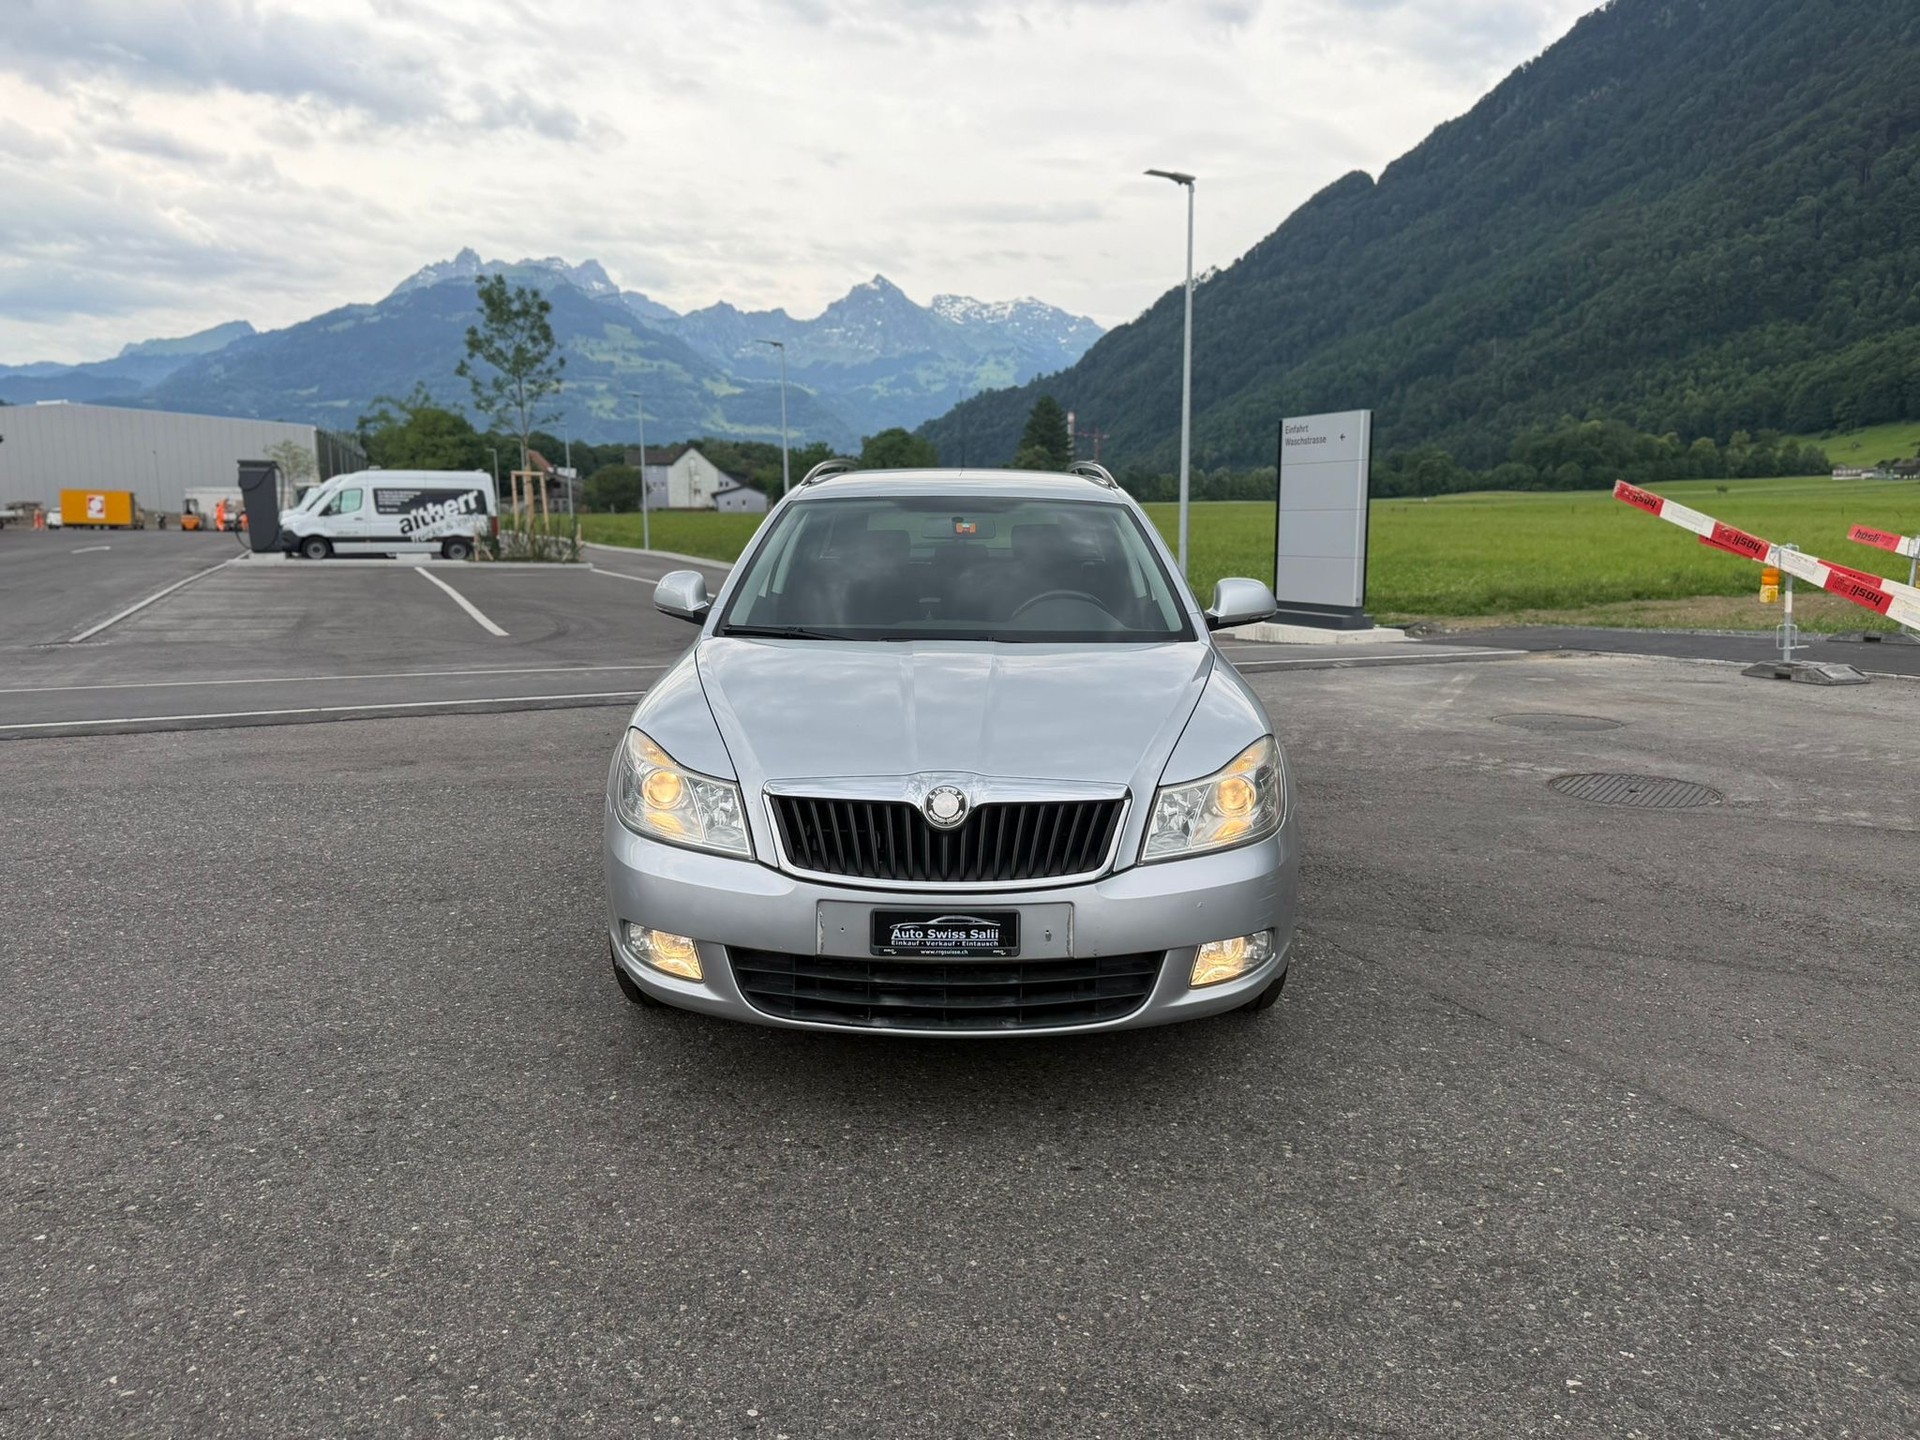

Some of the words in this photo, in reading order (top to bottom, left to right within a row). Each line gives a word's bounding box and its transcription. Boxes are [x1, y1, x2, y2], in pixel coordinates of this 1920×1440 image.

[1285, 425, 1309, 434] Einfahrt
[1285, 437, 1327, 446] Waschstrasse
[400, 490, 478, 534] altherr
[891, 929, 924, 939] Auto
[927, 929, 966, 939] Swiss
[970, 929, 999, 939] Salii
